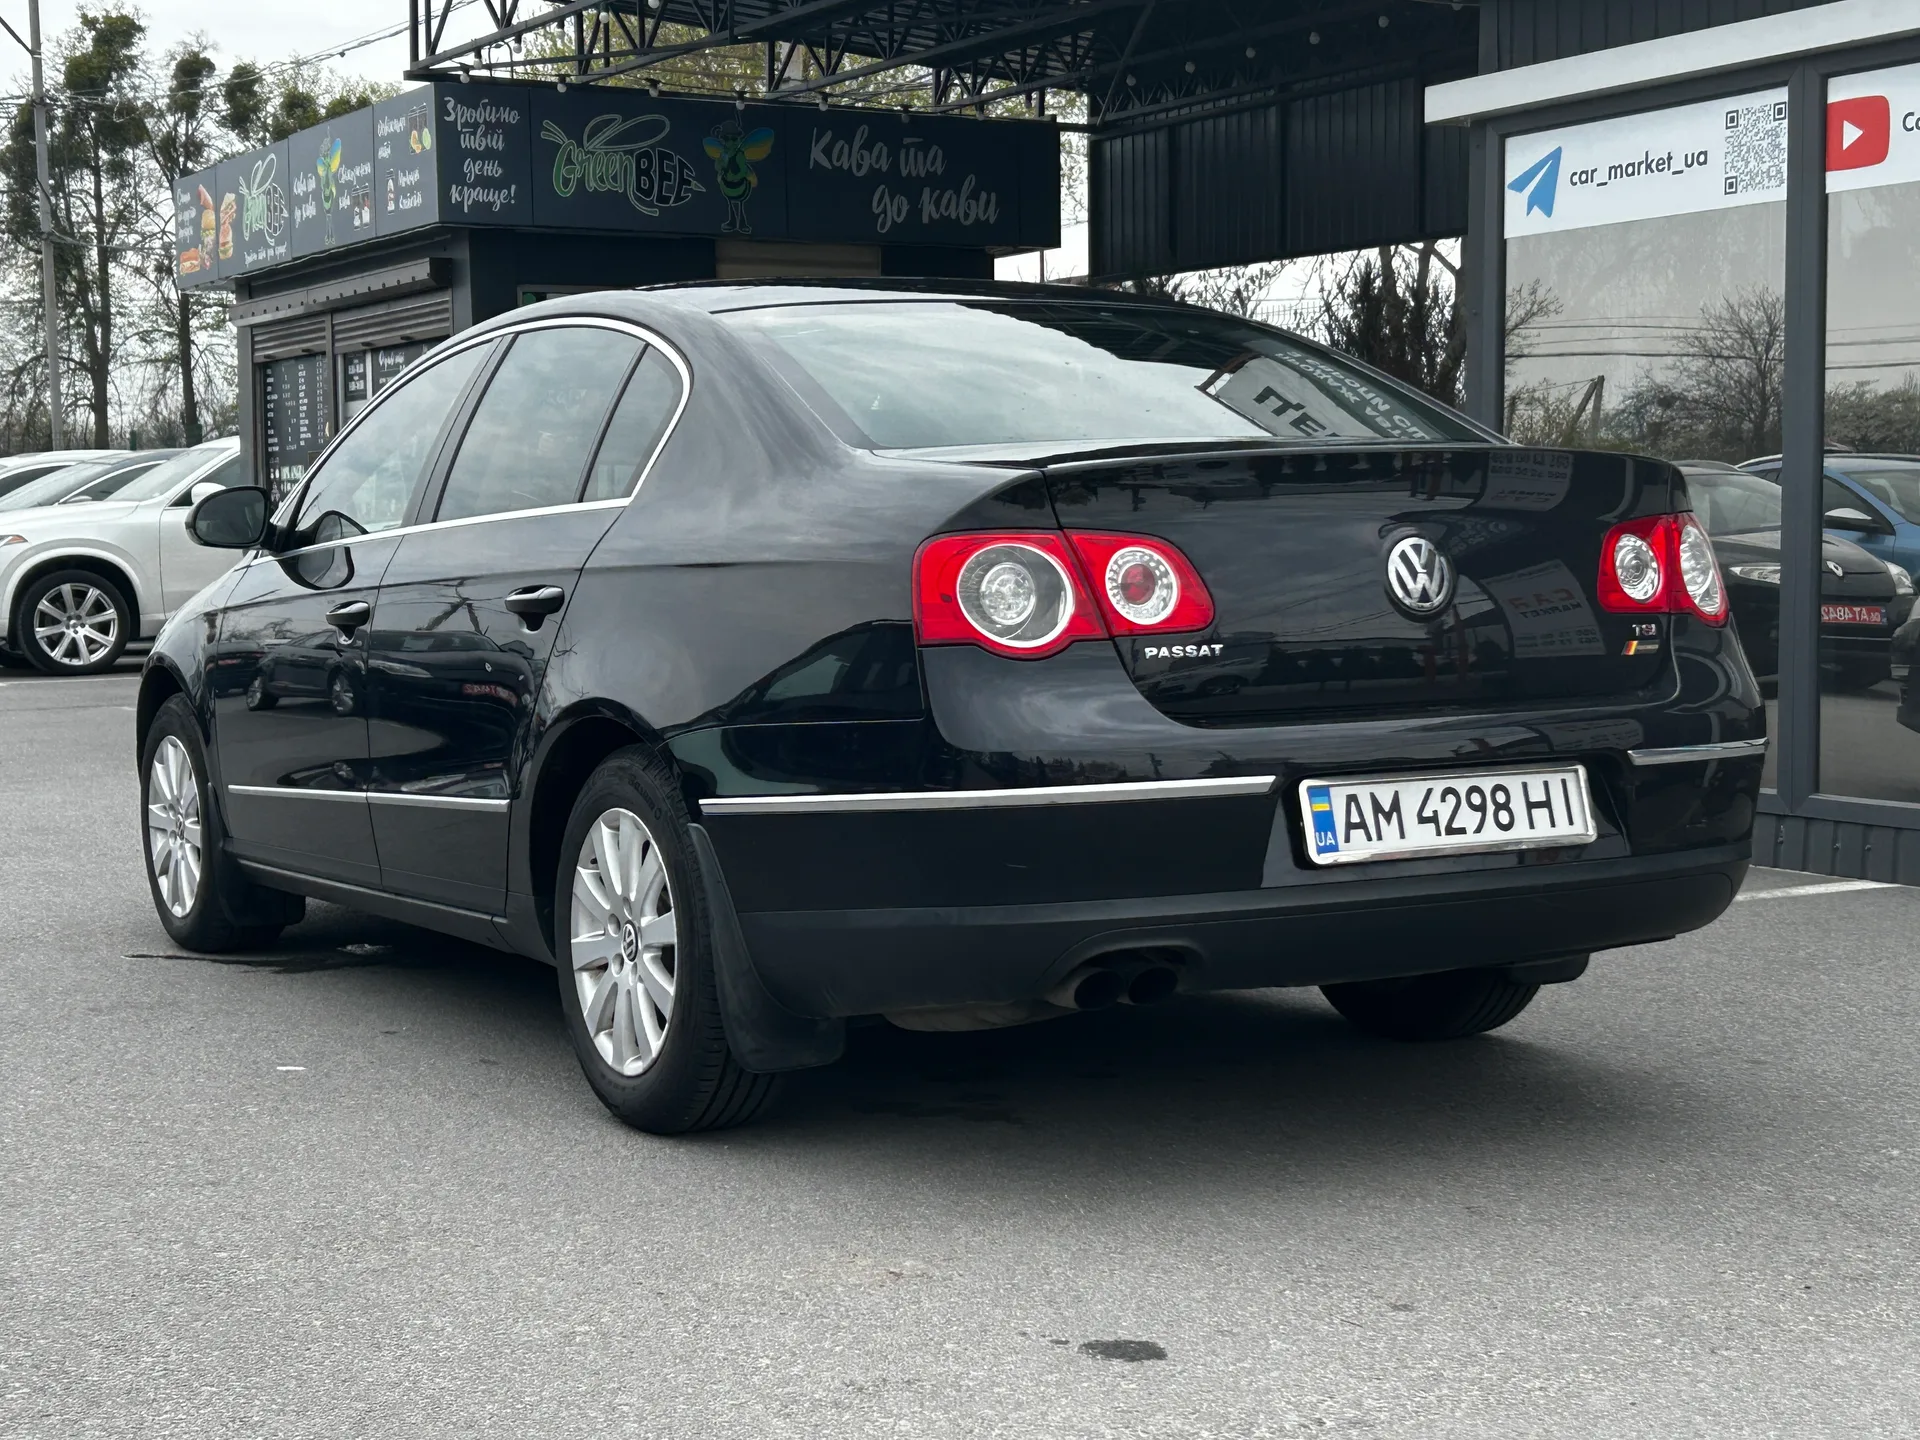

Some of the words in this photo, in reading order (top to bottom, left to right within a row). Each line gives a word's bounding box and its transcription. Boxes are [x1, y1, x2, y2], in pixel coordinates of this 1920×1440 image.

[444, 96, 520, 130] Зробимо
[460, 129, 505, 151] твій
[809, 125, 892, 176] Кава
[900, 138, 947, 177] та
[464, 157, 503, 182] день
[1569, 147, 1709, 188] car_market_ua
[450, 184, 516, 213] краще!
[872, 184, 910, 233] до
[919, 174, 1000, 226] кави
[1632, 623, 1656, 636] TSI
[1144, 644, 1224, 659] PASSAT
[1344, 790, 1405, 843] AM
[1417, 783, 1515, 836] 4298
[1522, 778, 1574, 830] HI
[1315, 831, 1335, 846] UA
